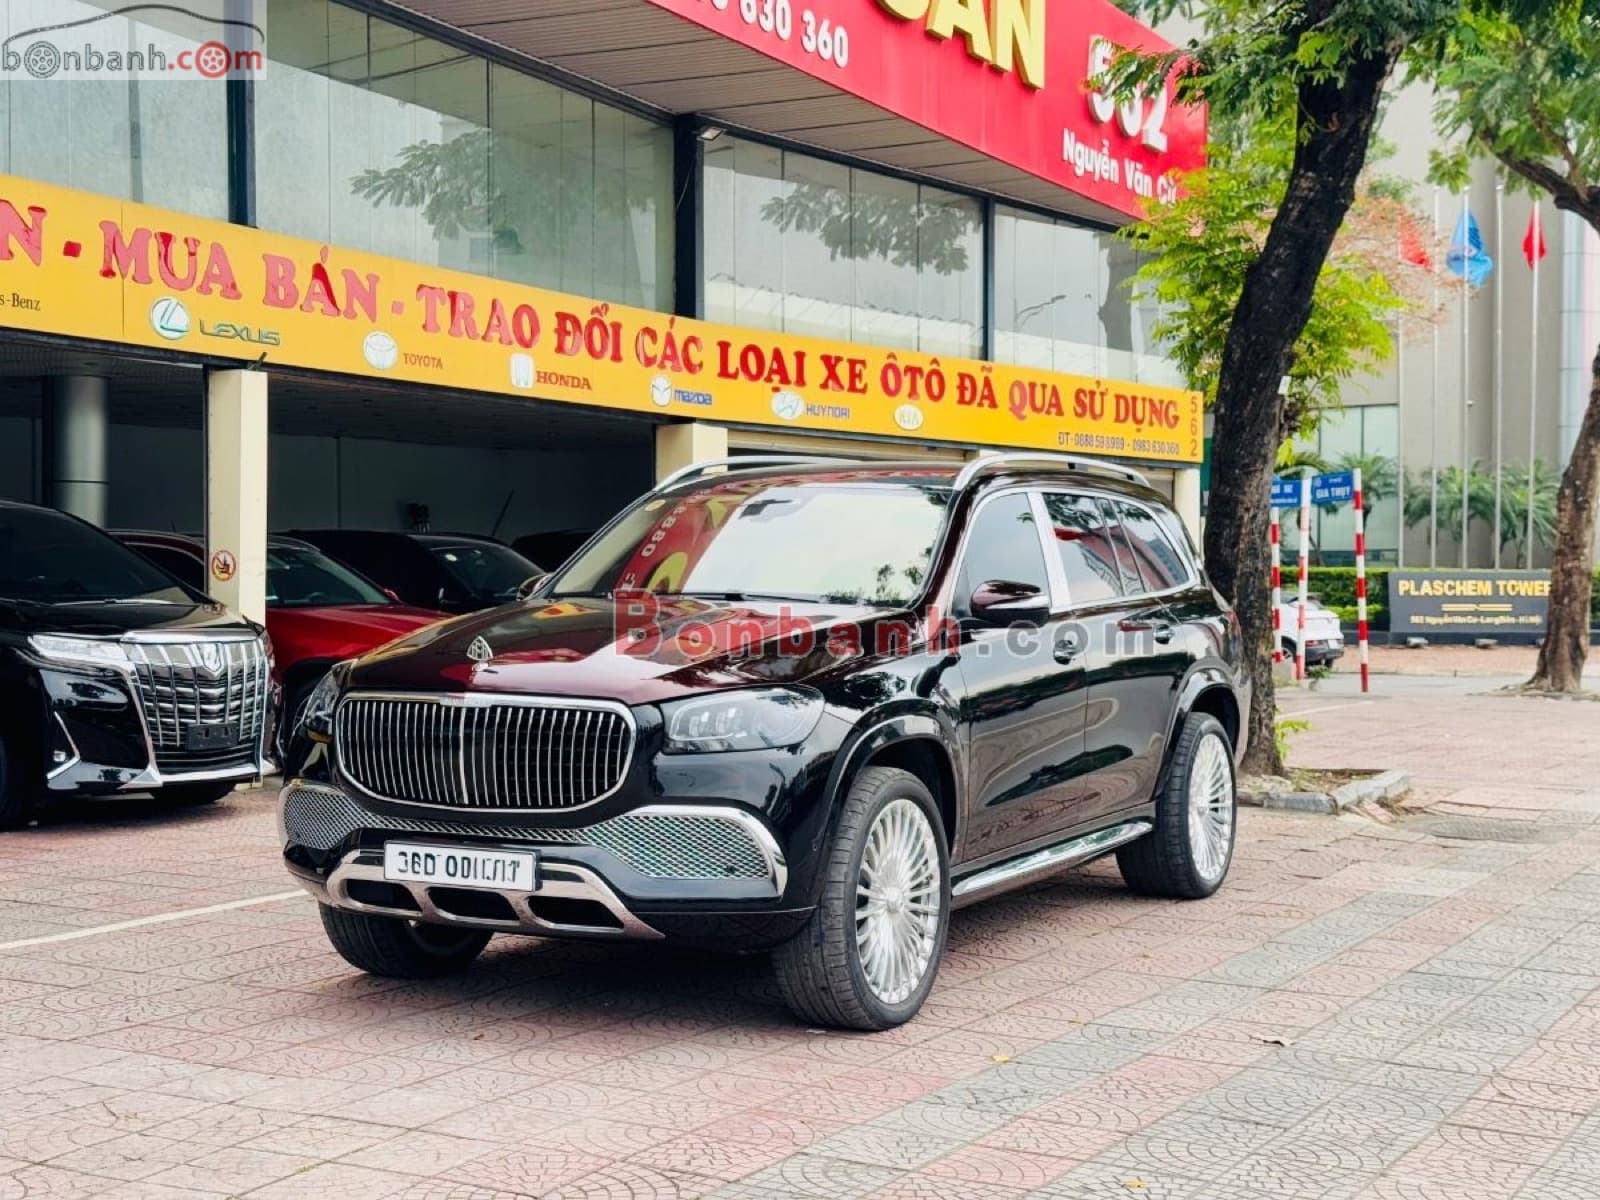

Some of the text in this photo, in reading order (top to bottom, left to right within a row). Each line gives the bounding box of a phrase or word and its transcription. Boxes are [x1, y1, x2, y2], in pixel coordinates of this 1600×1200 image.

[801, 9, 849, 69] 360
[99, 219, 243, 300] MUA
[262, 245, 380, 323] BÁN
[416, 284, 541, 349] TRAO
[553, 303, 622, 363] ĐỔI
[635, 316, 704, 375] CÁC
[717, 340, 807, 393] LOẠI
[819, 354, 869, 395] XE
[880, 352, 946, 402] ÔTÔ
[956, 366, 998, 409] ĐÃ
[1009, 380, 1064, 421] QUA
[1073, 380, 1108, 421] SỬ
[1114, 393, 1180, 432] DỤNG
[200, 320, 281, 346] LEXUS
[403, 352, 443, 369] TOYOTA
[536, 370, 592, 390] HONDA
[1398, 580, 1492, 597] PLASCHEM
